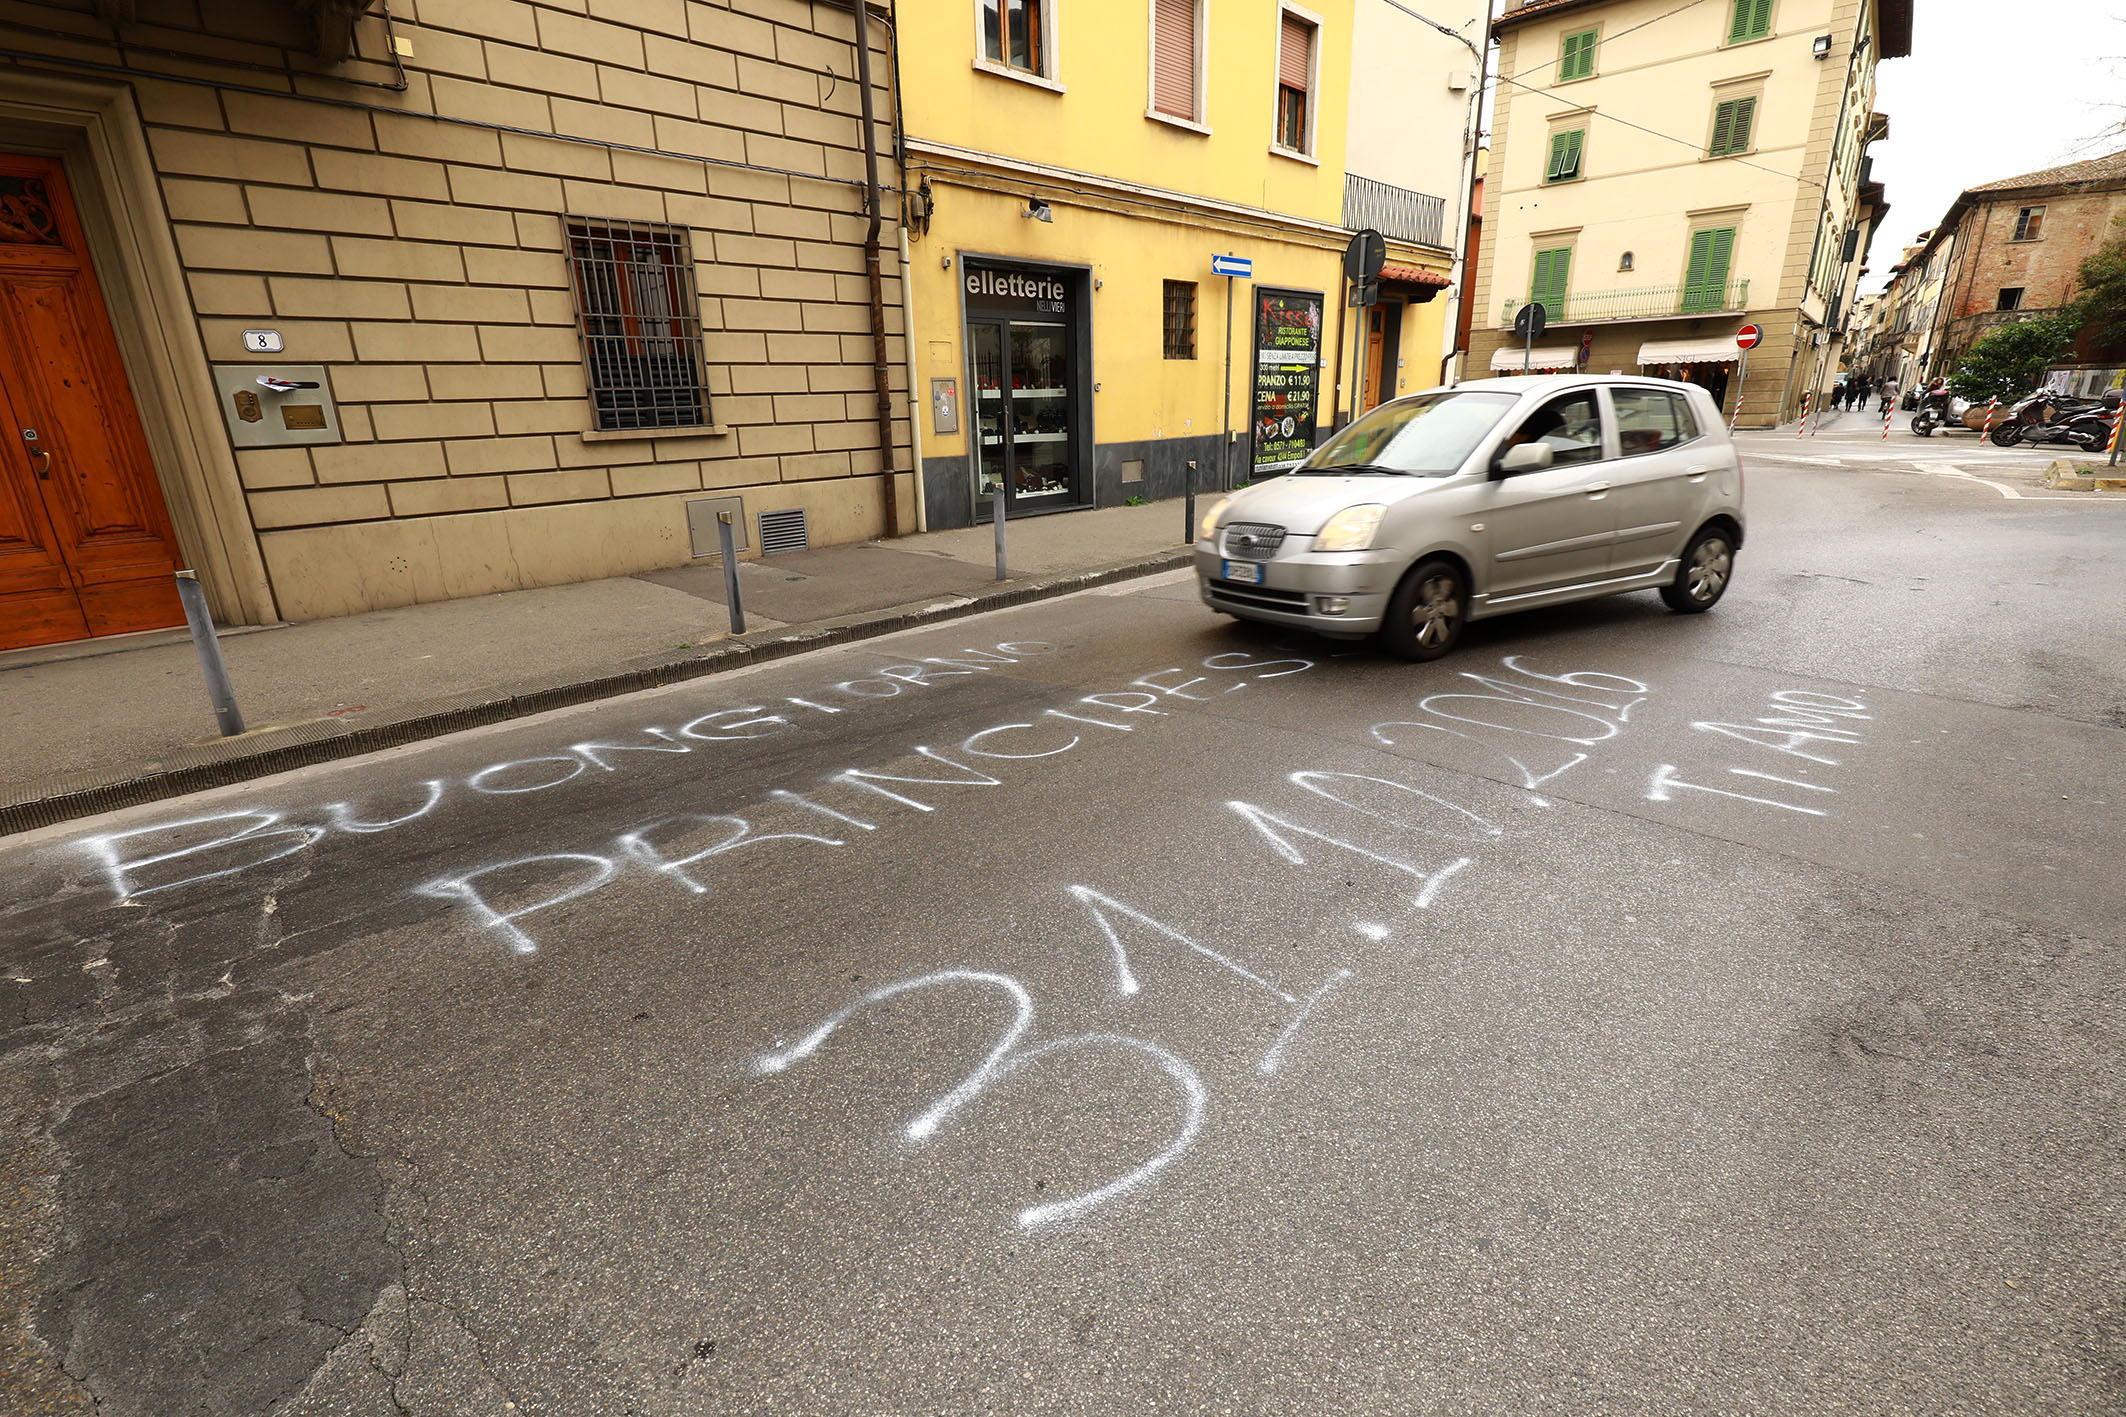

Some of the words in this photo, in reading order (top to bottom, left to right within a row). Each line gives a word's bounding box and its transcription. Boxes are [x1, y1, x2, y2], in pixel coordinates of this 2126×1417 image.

[966, 270, 1065, 300] elletterie
[1278, 327, 1308, 336] RISTORANTE
[258, 334, 267, 348] 8
[1275, 336, 1310, 346] GIAPPONESE
[1257, 375, 1286, 386] PRANZO
[1257, 391, 1276, 402] CENA
[1691, 690, 1873, 766] AMO
[76, 641, 1055, 902] BUONGIORNO
[1645, 764, 1838, 816] TI
